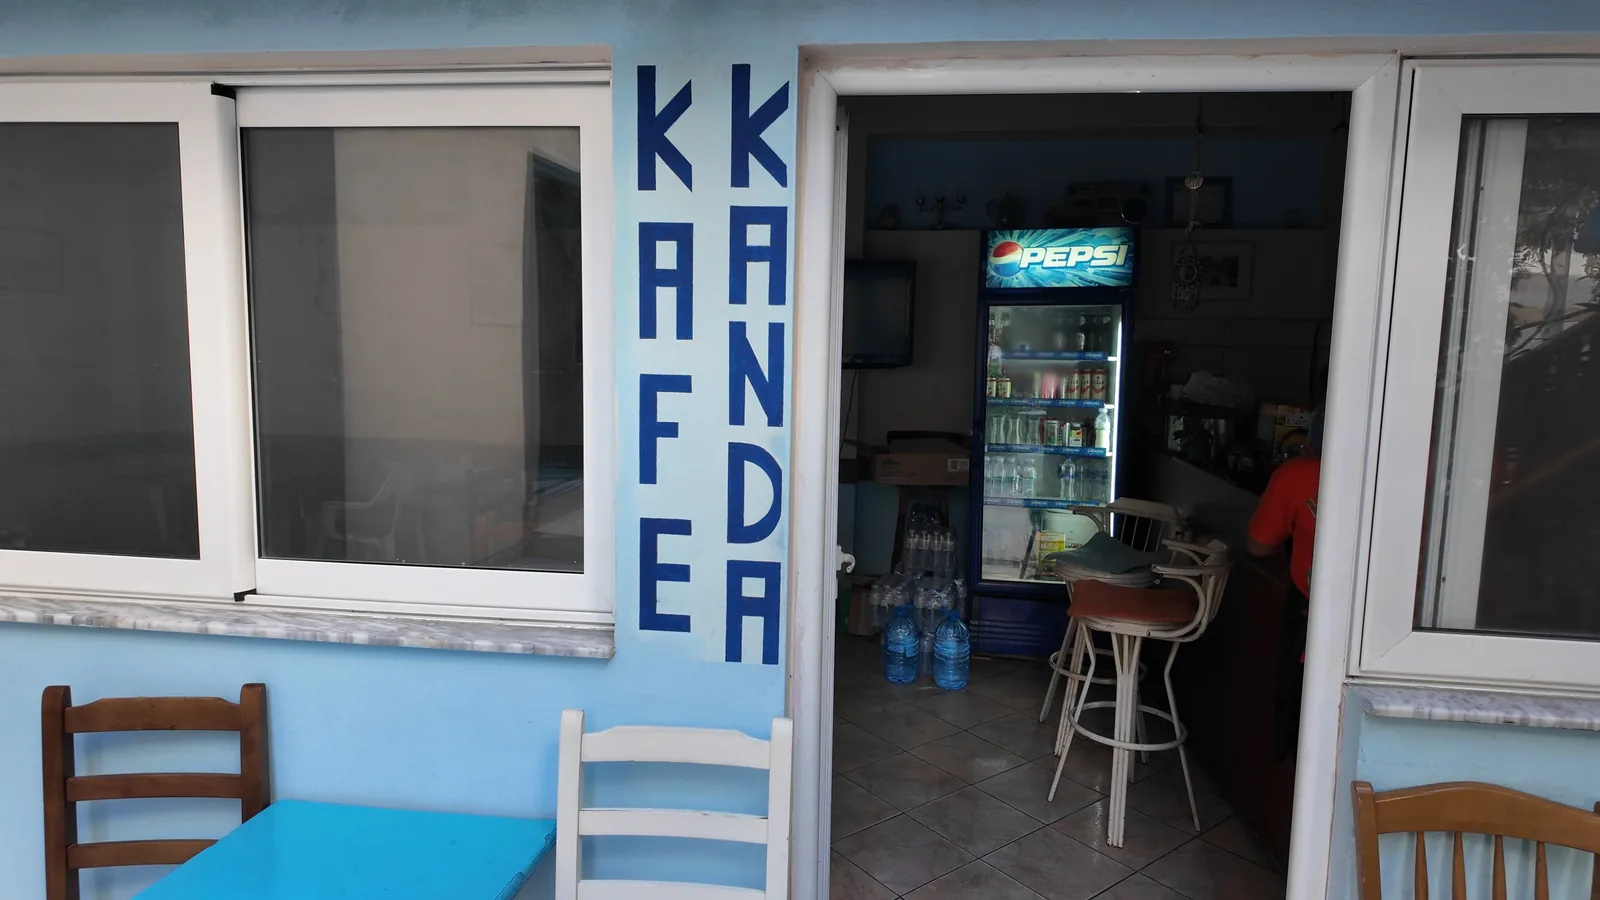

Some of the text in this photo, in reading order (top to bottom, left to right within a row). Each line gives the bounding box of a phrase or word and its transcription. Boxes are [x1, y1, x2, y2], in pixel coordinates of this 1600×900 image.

[637, 65, 694, 633] KAFE
[725, 64, 789, 665] KANDA
[1019, 245, 1128, 268] PEPSI
